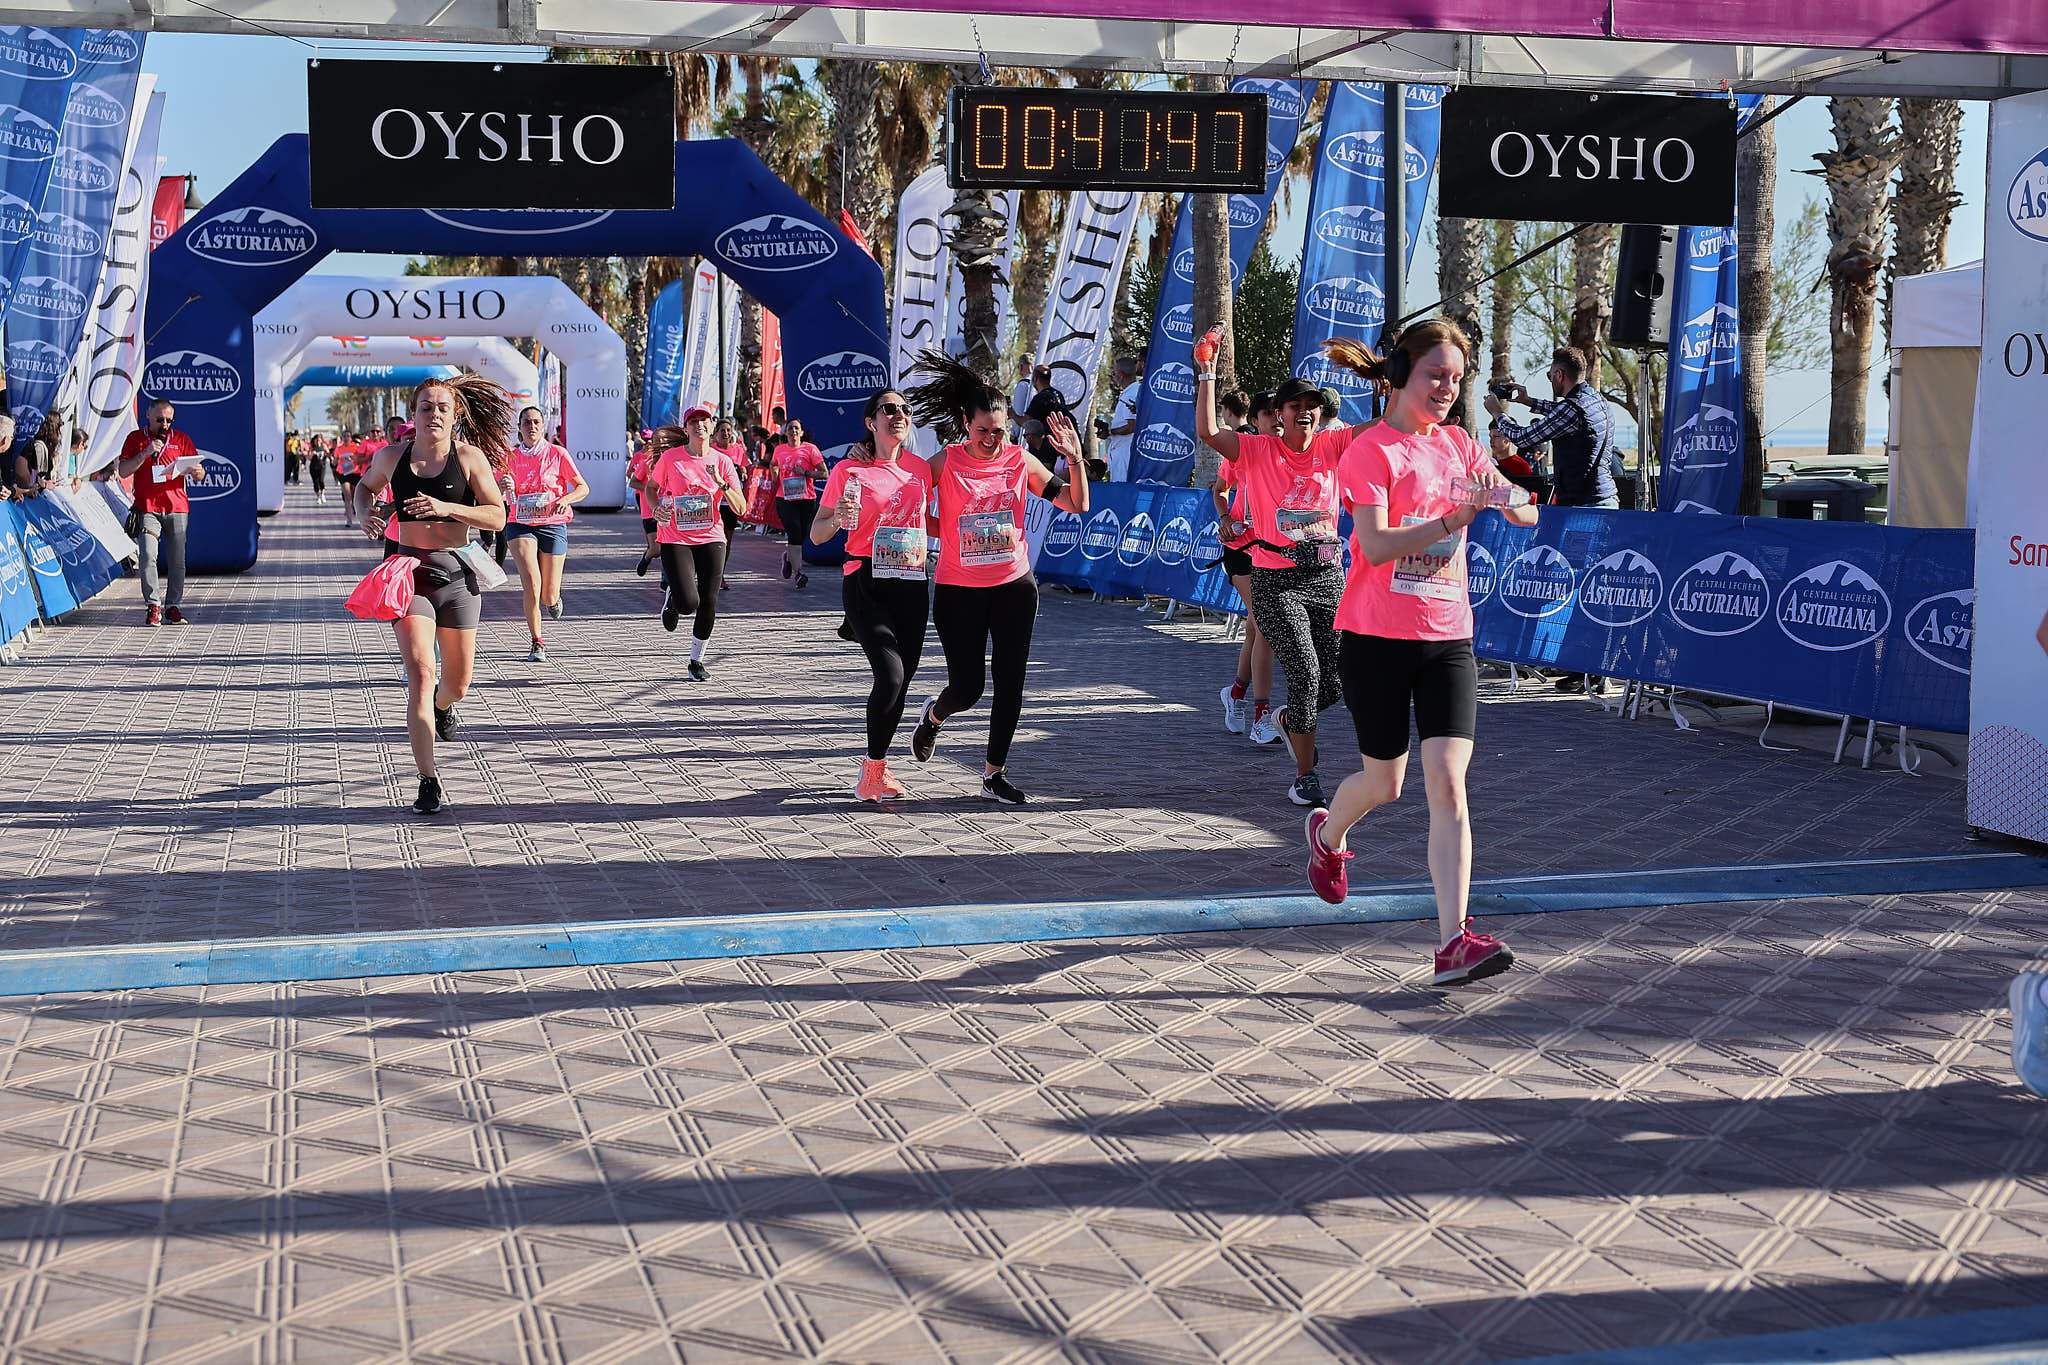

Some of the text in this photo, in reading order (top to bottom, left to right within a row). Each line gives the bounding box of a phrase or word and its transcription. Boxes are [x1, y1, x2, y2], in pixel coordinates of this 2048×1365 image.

[372, 108, 625, 165] OYSHO
[976, 104, 1244, 171] 00:41:47
[1490, 131, 1695, 183] OYSHO
[194, 228, 307, 252] ASTURIANA
[215, 226, 305, 235] CENTRAL LECHERA
[741, 231, 824, 241] CENTRAL LECHERA
[725, 238, 831, 258] ASTURIANA
[345, 288, 506, 320] OYSHO
[898, 217, 945, 384] YSHO
[1311, 290, 1385, 320] ASTURIANA
[551, 323, 598, 334] OYSHO
[145, 370, 234, 392] ASTURIANA
[576, 388, 620, 398] OYSHO
[804, 371, 885, 391] ASTURIANA
[576, 451, 620, 461] OYSHO
[1503, 569, 1567, 601] ASTURIANA
[1583, 575, 1653, 609] ASTURIANA
[1695, 579, 1761, 592] CENTRAL LECHERA
[1803, 589, 1878, 605] CENTRAL LECHERA
[1674, 581, 1760, 618] ASTURIANA
[1782, 589, 1877, 632] ASTURIANA
